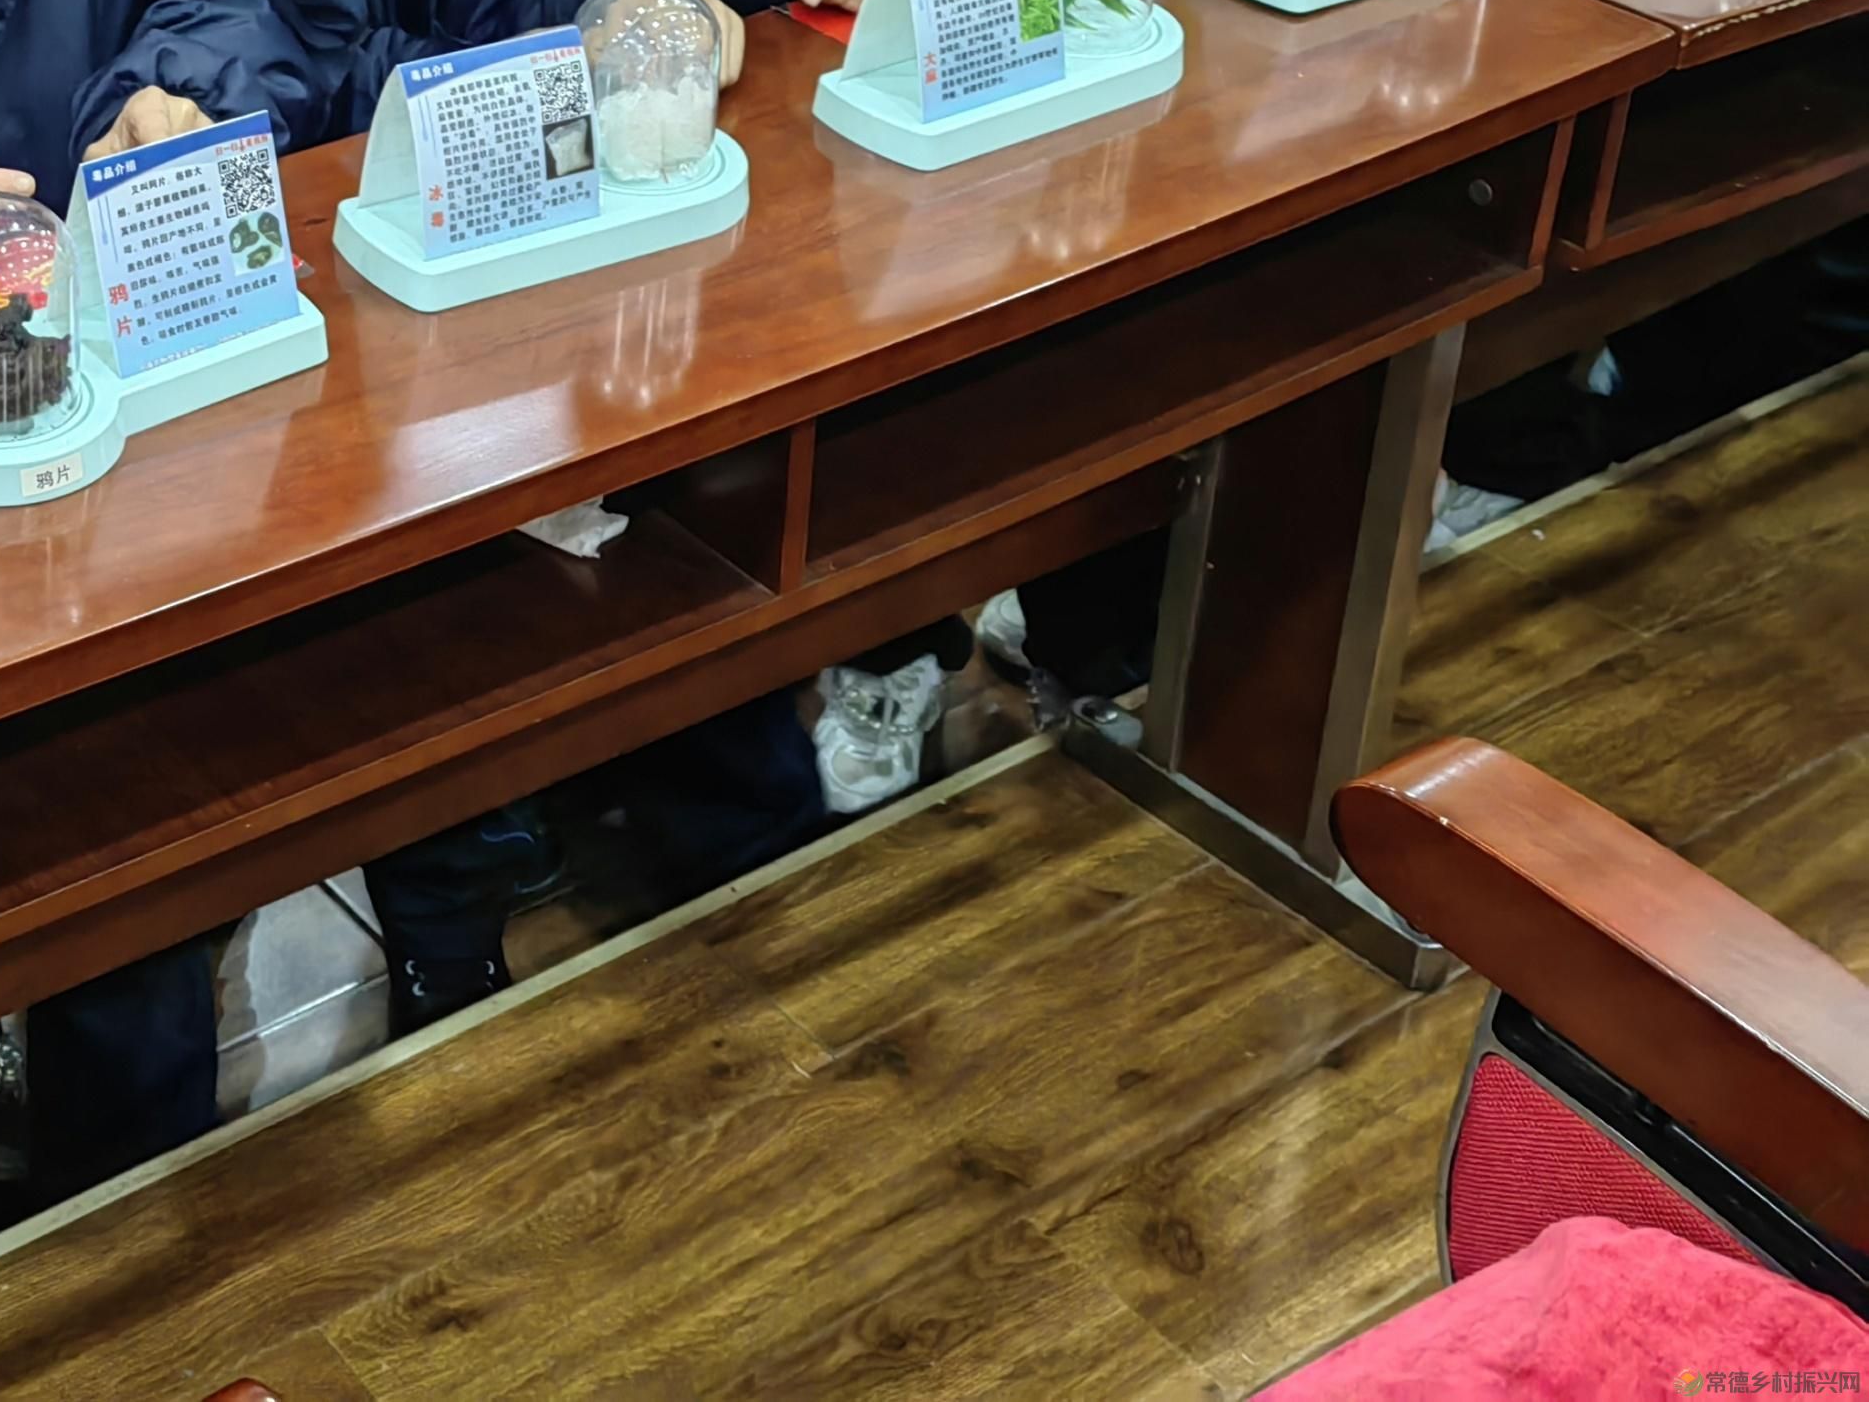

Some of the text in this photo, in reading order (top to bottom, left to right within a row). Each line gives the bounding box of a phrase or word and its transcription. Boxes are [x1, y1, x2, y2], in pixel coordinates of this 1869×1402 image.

[90, 158, 137, 184] 毒品介绍
[107, 281, 136, 338] 鸦片
[35, 466, 71, 490] 鸦片
